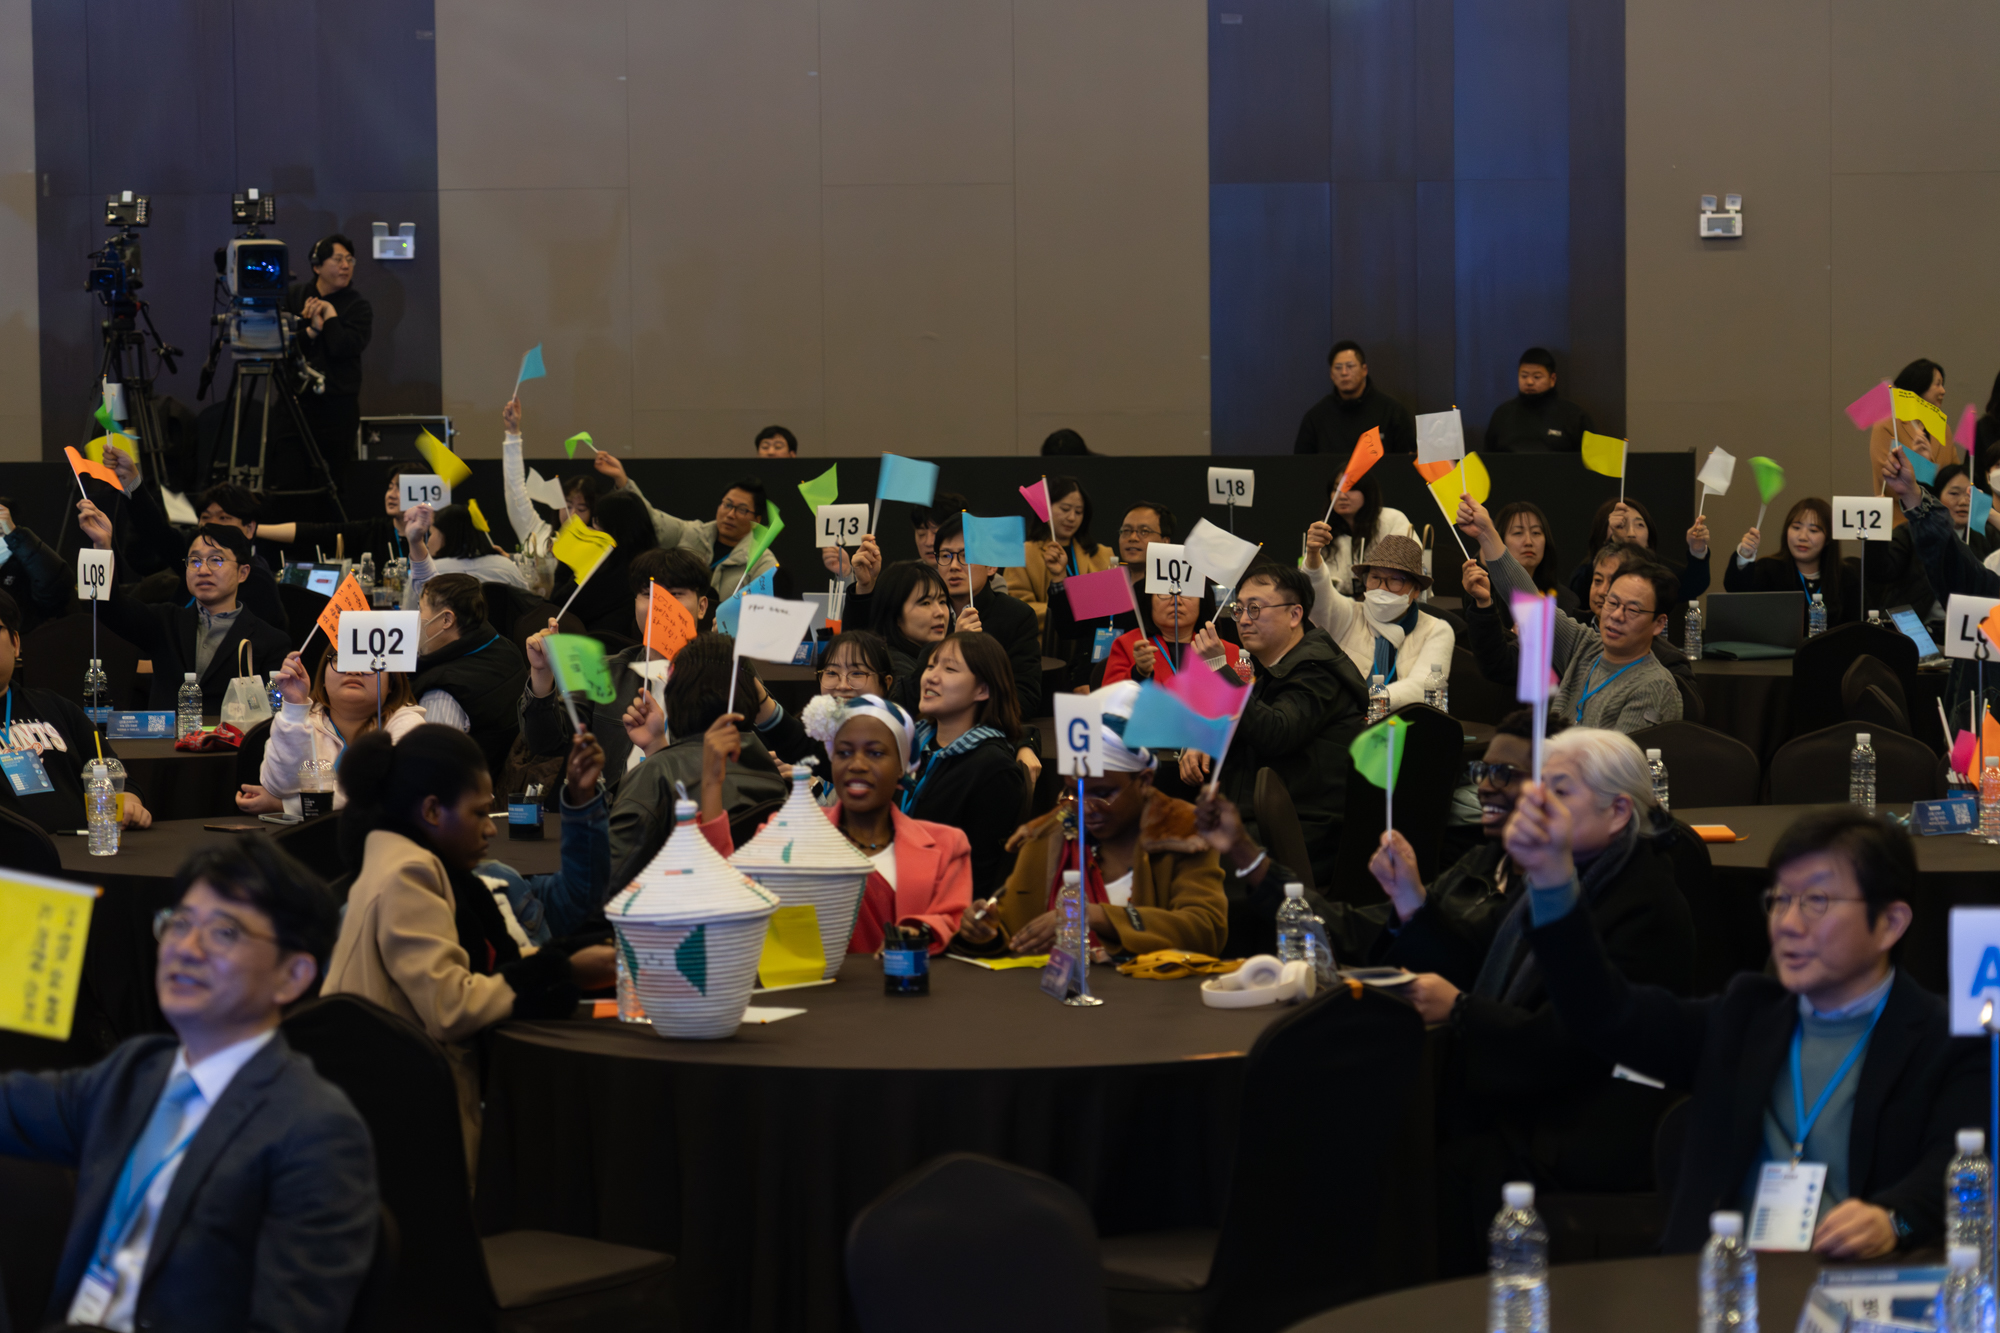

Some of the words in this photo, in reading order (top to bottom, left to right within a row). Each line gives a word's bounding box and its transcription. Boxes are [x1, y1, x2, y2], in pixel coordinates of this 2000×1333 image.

[408, 485, 442, 502] L19
[1215, 478, 1245, 496] L18
[825, 517, 860, 536] L13
[1842, 509, 1882, 529] L12
[83, 563, 105, 586] L08
[1156, 558, 1193, 582] L07
[352, 627, 405, 655] L02
[1068, 717, 1090, 753] G
[1970, 946, 2000, 998] A
